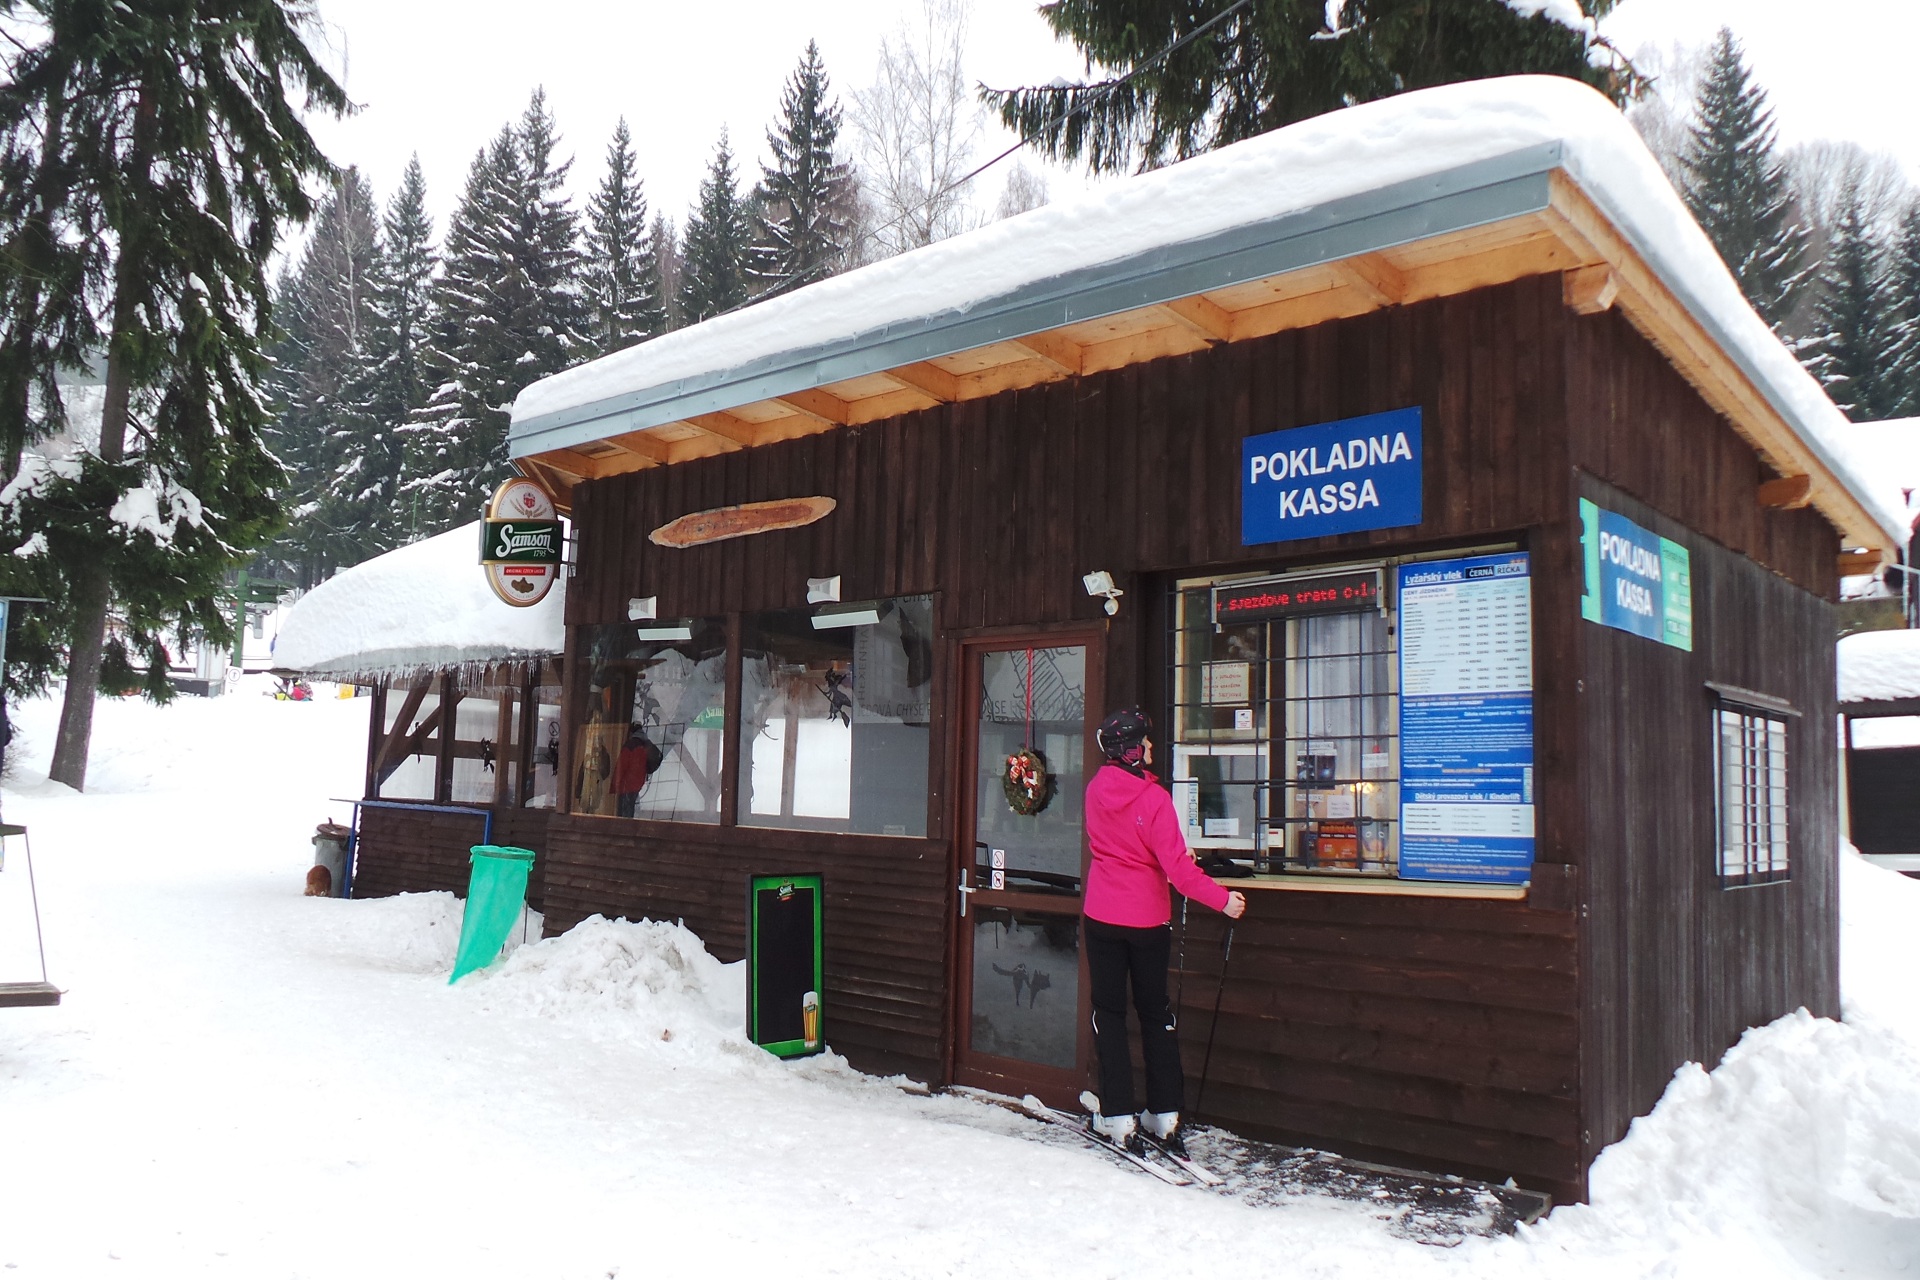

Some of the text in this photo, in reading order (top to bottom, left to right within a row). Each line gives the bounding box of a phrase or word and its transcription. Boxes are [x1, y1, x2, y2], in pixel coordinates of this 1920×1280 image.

[1250, 431, 1412, 484] POKLADNA
[1279, 479, 1380, 519] KASSA
[495, 524, 555, 558] Samson
[533, 549, 546, 557] 1795
[1600, 531, 1661, 582] POKLADNA
[1405, 571, 1441, 584] Lyžařský
[1444, 570, 1462, 580] vlek
[1469, 566, 1493, 577] ČERNÁ
[1229, 593, 1289, 611] sjezdove
[1296, 588, 1337, 603] trate
[1616, 577, 1653, 616] KASSA
